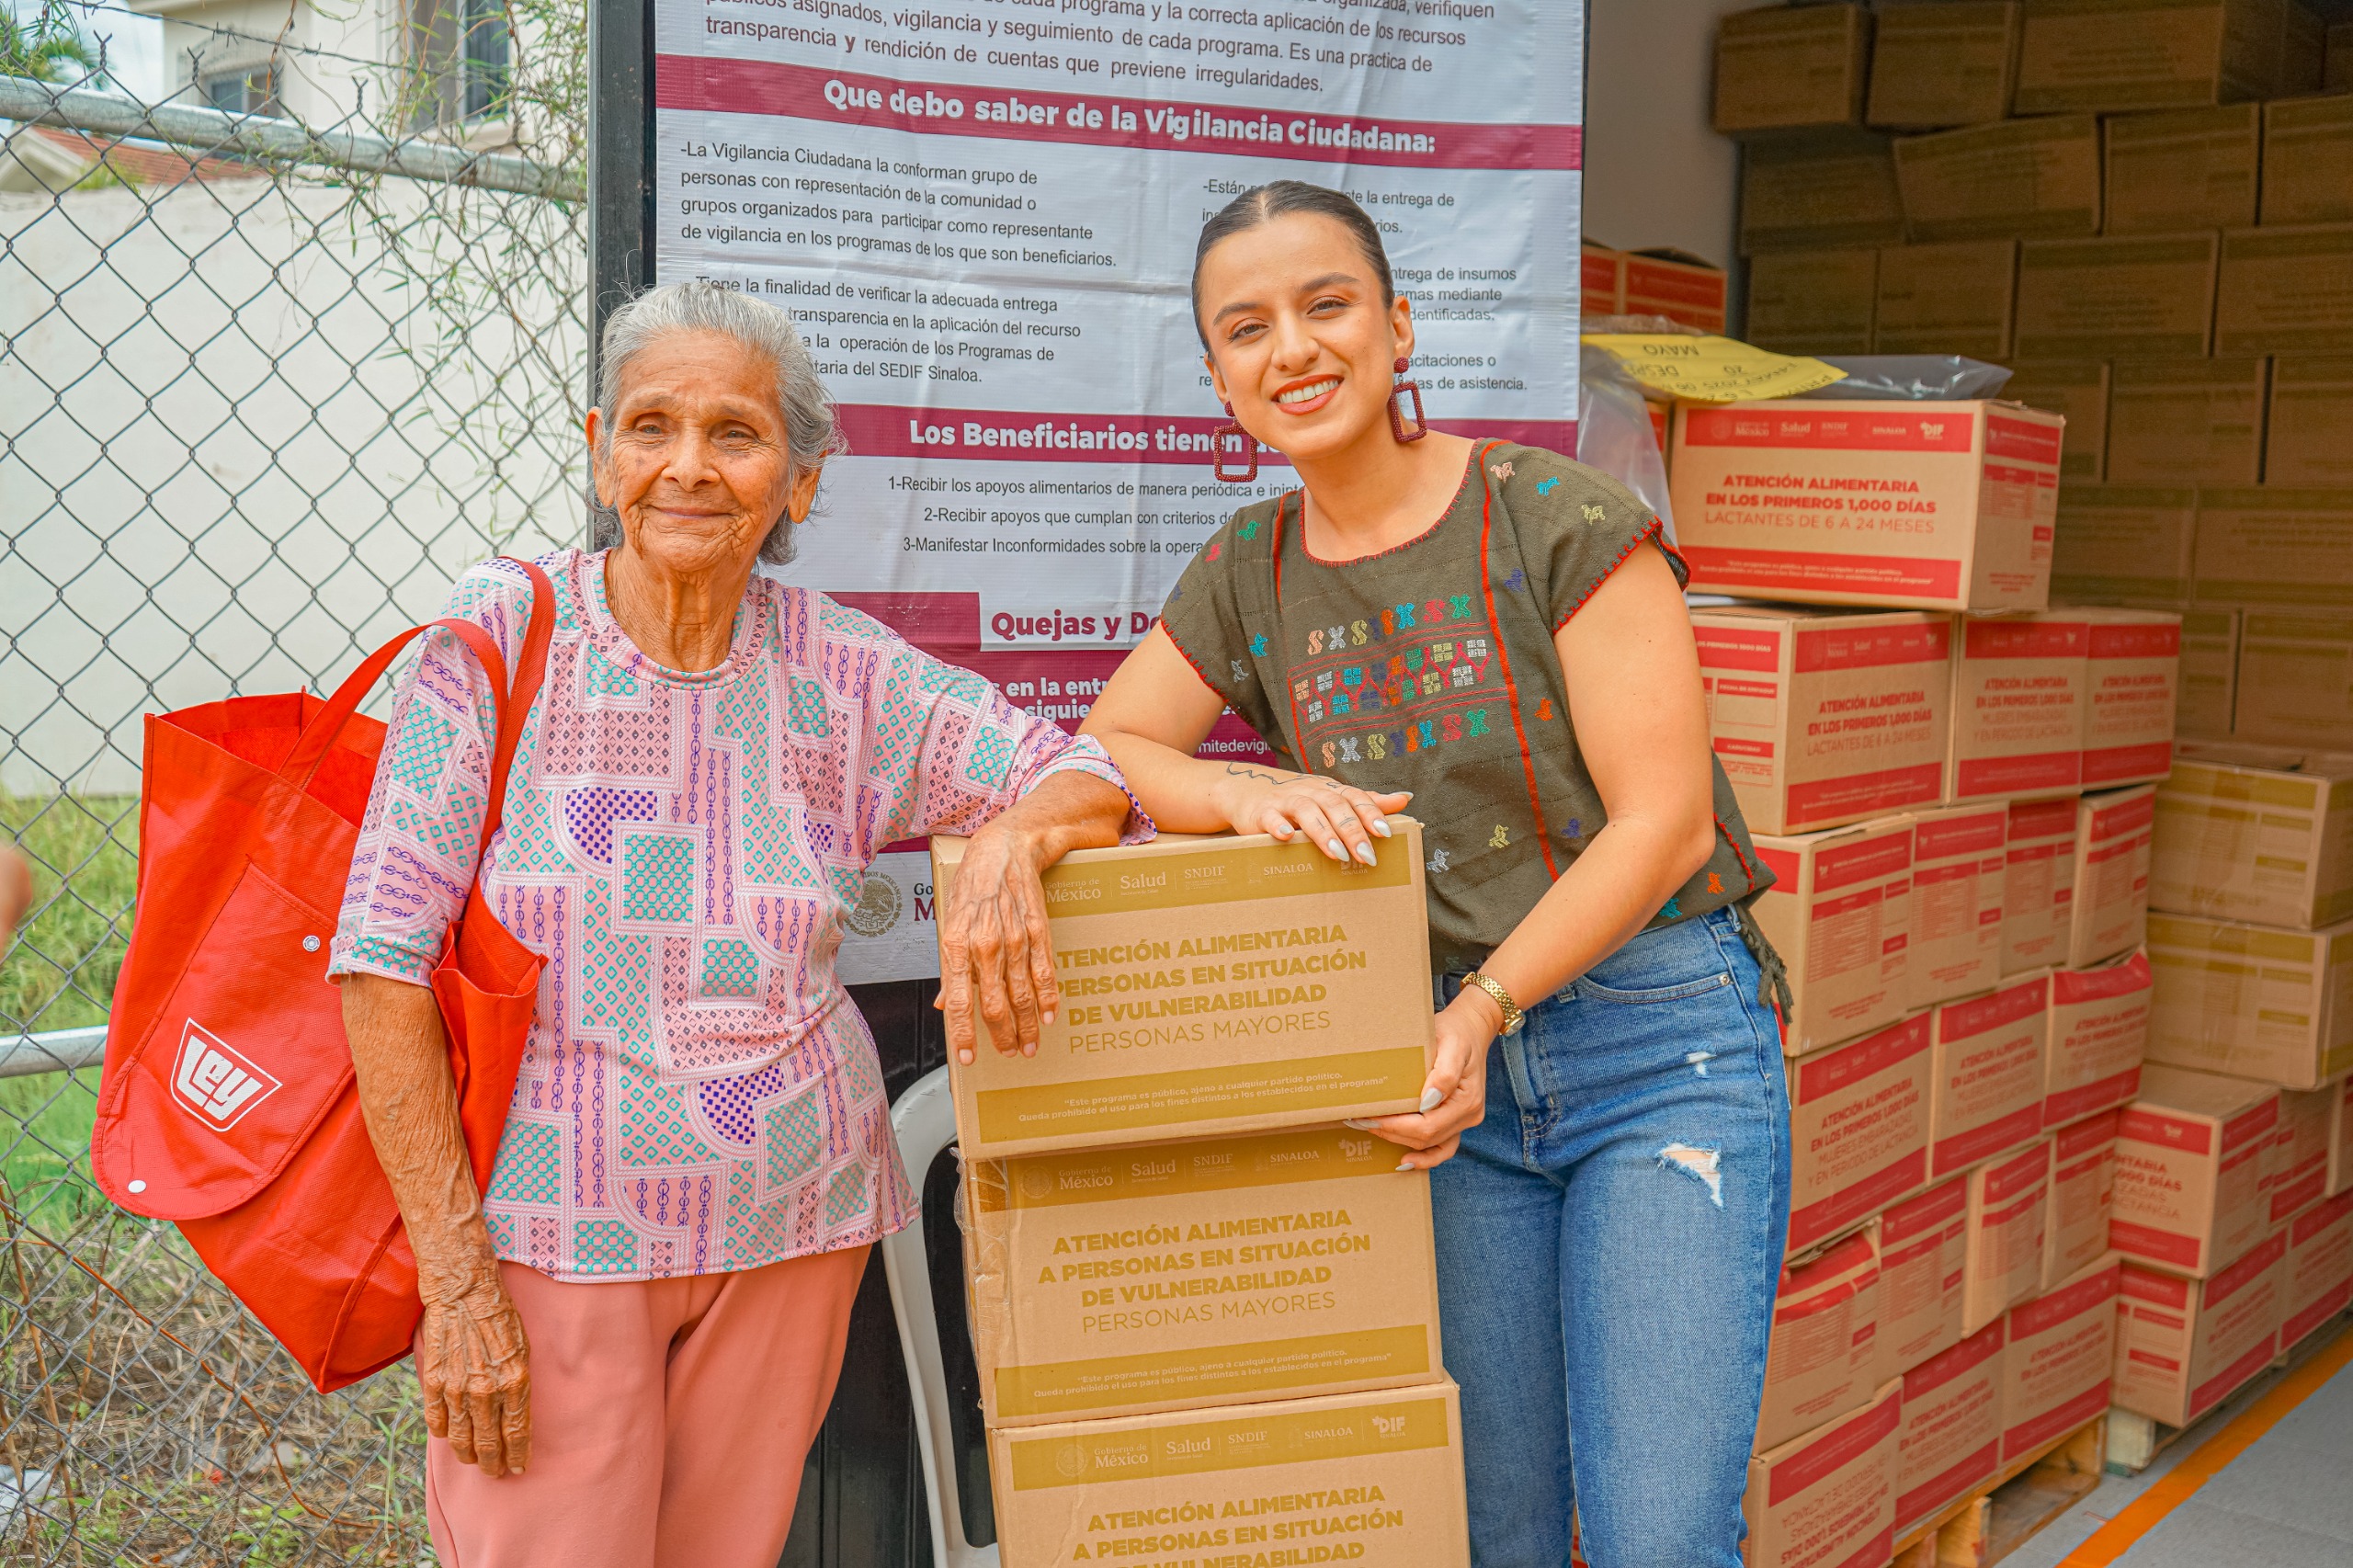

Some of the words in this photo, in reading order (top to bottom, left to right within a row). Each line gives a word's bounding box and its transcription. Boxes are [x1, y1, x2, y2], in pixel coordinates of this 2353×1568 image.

[792, 0, 888, 28] asignados,
[892, 10, 982, 32] vigilancia
[987, 19, 998, 38] y
[1003, 21, 1113, 44] seguimiento
[1121, 28, 1143, 47] de
[1148, 31, 1191, 51] cada
[1198, 38, 1283, 59] programa.
[1289, 41, 1311, 61] Es
[1315, 49, 1345, 64] una
[1349, 51, 1406, 71] practica
[1411, 54, 1433, 73] de
[1151, 4, 1163, 22] y
[1166, 0, 1183, 20] la
[1188, 6, 1258, 27] correcta
[1263, 11, 1345, 35] aplicación
[1348, 18, 1370, 37] de
[1374, 20, 1393, 40] los
[1397, 28, 1466, 46] recursos
[705, 16, 836, 47] transparencia
[844, 34, 857, 54] y
[864, 38, 946, 61] rendición
[953, 43, 977, 62] de
[987, 51, 1059, 70] cuentas
[1065, 57, 1099, 75] que
[1110, 61, 1187, 80] previene
[1196, 67, 1323, 92] irregularidades.
[824, 79, 882, 110] Que
[889, 88, 964, 119] debo
[974, 97, 1059, 125] saber
[1066, 102, 1103, 129] de
[1111, 105, 1137, 131] la
[1143, 108, 1283, 142] Vigilancia
[1288, 118, 1435, 153] Ciudadana:
[680, 141, 707, 157] -La
[711, 142, 790, 163] Vigilancia
[794, 147, 872, 171] Ciudadana
[876, 156, 889, 173] la
[892, 162, 967, 180] conforman
[972, 169, 1015, 186] grupo
[1018, 169, 1038, 185] de
[681, 171, 756, 187] personas
[761, 176, 790, 189] con
[795, 178, 901, 200] representación
[904, 187, 922, 203] de
[924, 189, 936, 205] la
[940, 193, 1022, 210] comunidad
[1027, 199, 1037, 210] o
[680, 199, 737, 216] grupos
[742, 200, 837, 220] organizados
[842, 209, 873, 224] para
[881, 212, 943, 233] participar
[947, 221, 988, 233] como
[992, 223, 1093, 240] representante
[1437, 267, 1455, 280] de
[1459, 267, 1517, 280] insumos
[745, 278, 760, 293] la
[764, 278, 831, 296] finalidad
[835, 282, 854, 298] de
[858, 286, 912, 303] verificar
[915, 289, 927, 304] la
[931, 291, 999, 309] adecuada
[1003, 296, 1058, 315] entrega
[1438, 288, 1502, 301] mediante
[1437, 376, 1455, 390] de
[1459, 376, 1528, 391] asistencia.
[909, 419, 956, 445] Los
[963, 422, 1149, 450] Beneficiarios
[888, 475, 948, 492] 1-Recibir
[951, 477, 972, 493] los
[975, 481, 1025, 496] apoyos
[1029, 479, 1112, 495] alimentarios
[1116, 481, 1134, 495] de
[1139, 484, 1188, 496] manera
[1191, 483, 1253, 499] periódica
[1256, 485, 1266, 497] e
[1722, 473, 1804, 489] ATENCIÓN
[1807, 477, 1919, 494] ALIMENTARIA
[1705, 492, 1727, 506] EN
[1729, 494, 1759, 507] LOS
[1762, 494, 1844, 510] PRIMEROS
[1847, 498, 1893, 513] 1,000
[1895, 497, 1937, 515] DÍAS
[1703, 510, 1794, 528] LACTANTES
[1798, 513, 1819, 529] DE
[1824, 514, 1835, 530] 6
[1838, 516, 1851, 529] A
[1855, 517, 1875, 531] 24
[1879, 517, 1935, 534] MESES
[903, 536, 989, 552] 3-Manifestar
[993, 537, 1106, 553] Inconformidades
[1108, 539, 1146, 553] sobre
[1150, 539, 1161, 553] la
[991, 608, 1096, 642] Quejas
[1102, 616, 1122, 641] y
[1819, 695, 1868, 714] ATENCIÓN
[1120, 871, 1166, 890] Salud
[1184, 865, 1224, 880] SNDIF
[1263, 862, 1313, 876] SINALOA
[1046, 887, 1101, 903] México
[1052, 937, 1171, 971] TENCIÓN
[1176, 924, 1348, 959] ALIMENTARIA
[1191, 964, 1226, 985] EN
[1231, 948, 1367, 981] SITUACIÓN
[1067, 1006, 1103, 1027] DE
[1107, 983, 1327, 1022] VULNERABILIDAD
[1069, 1023, 1205, 1054] PERSONAS
[1212, 1010, 1331, 1040] MAYORES
[1063, 1097, 1090, 1107] “Este
[1091, 1093, 1137, 1106] programa
[1151, 1088, 1188, 1099] público,
[1190, 1085, 1216, 1095] ajeno
[1225, 1079, 1268, 1090] cualquier
[1269, 1074, 1304, 1086] partido
[1305, 1072, 1343, 1084] político.
[1131, 1160, 1176, 1176] Salud
[1193, 1153, 1233, 1166] SNDIF
[1270, 1150, 1320, 1163] SINALOA
[1346, 1140, 1372, 1157] DIF
[1059, 1174, 1114, 1190] México
[1052, 1223, 1181, 1256] ATENCIÓN
[1186, 1209, 1353, 1242] ALIMENTARIA
[1038, 1266, 1057, 1284] A
[1062, 1252, 1196, 1282] PERSONAS
[1199, 1247, 1233, 1267] EN
[1238, 1232, 1370, 1264] SITUACIÓN
[1081, 1287, 1115, 1308] DE
[1119, 1266, 1332, 1303] VULNERABILIDAD
[1082, 1303, 1213, 1334] PERSONAS
[1221, 1290, 1336, 1320] MAYORES
[1165, 1437, 1211, 1455] Salud
[1228, 1431, 1267, 1444] SNDIF
[1304, 1426, 1353, 1440] SINALOA
[1379, 1416, 1405, 1434] DIF
[1095, 1451, 1148, 1469] México
[1087, 1500, 1215, 1532] ATENCIÓN
[1220, 1484, 1386, 1518] ALIMENTARIA
[1072, 1542, 1092, 1562] A
[1096, 1528, 1230, 1559] PERSONAS
[1234, 1524, 1267, 1545] EN
[1272, 1507, 1404, 1540] SITUACIÓN
